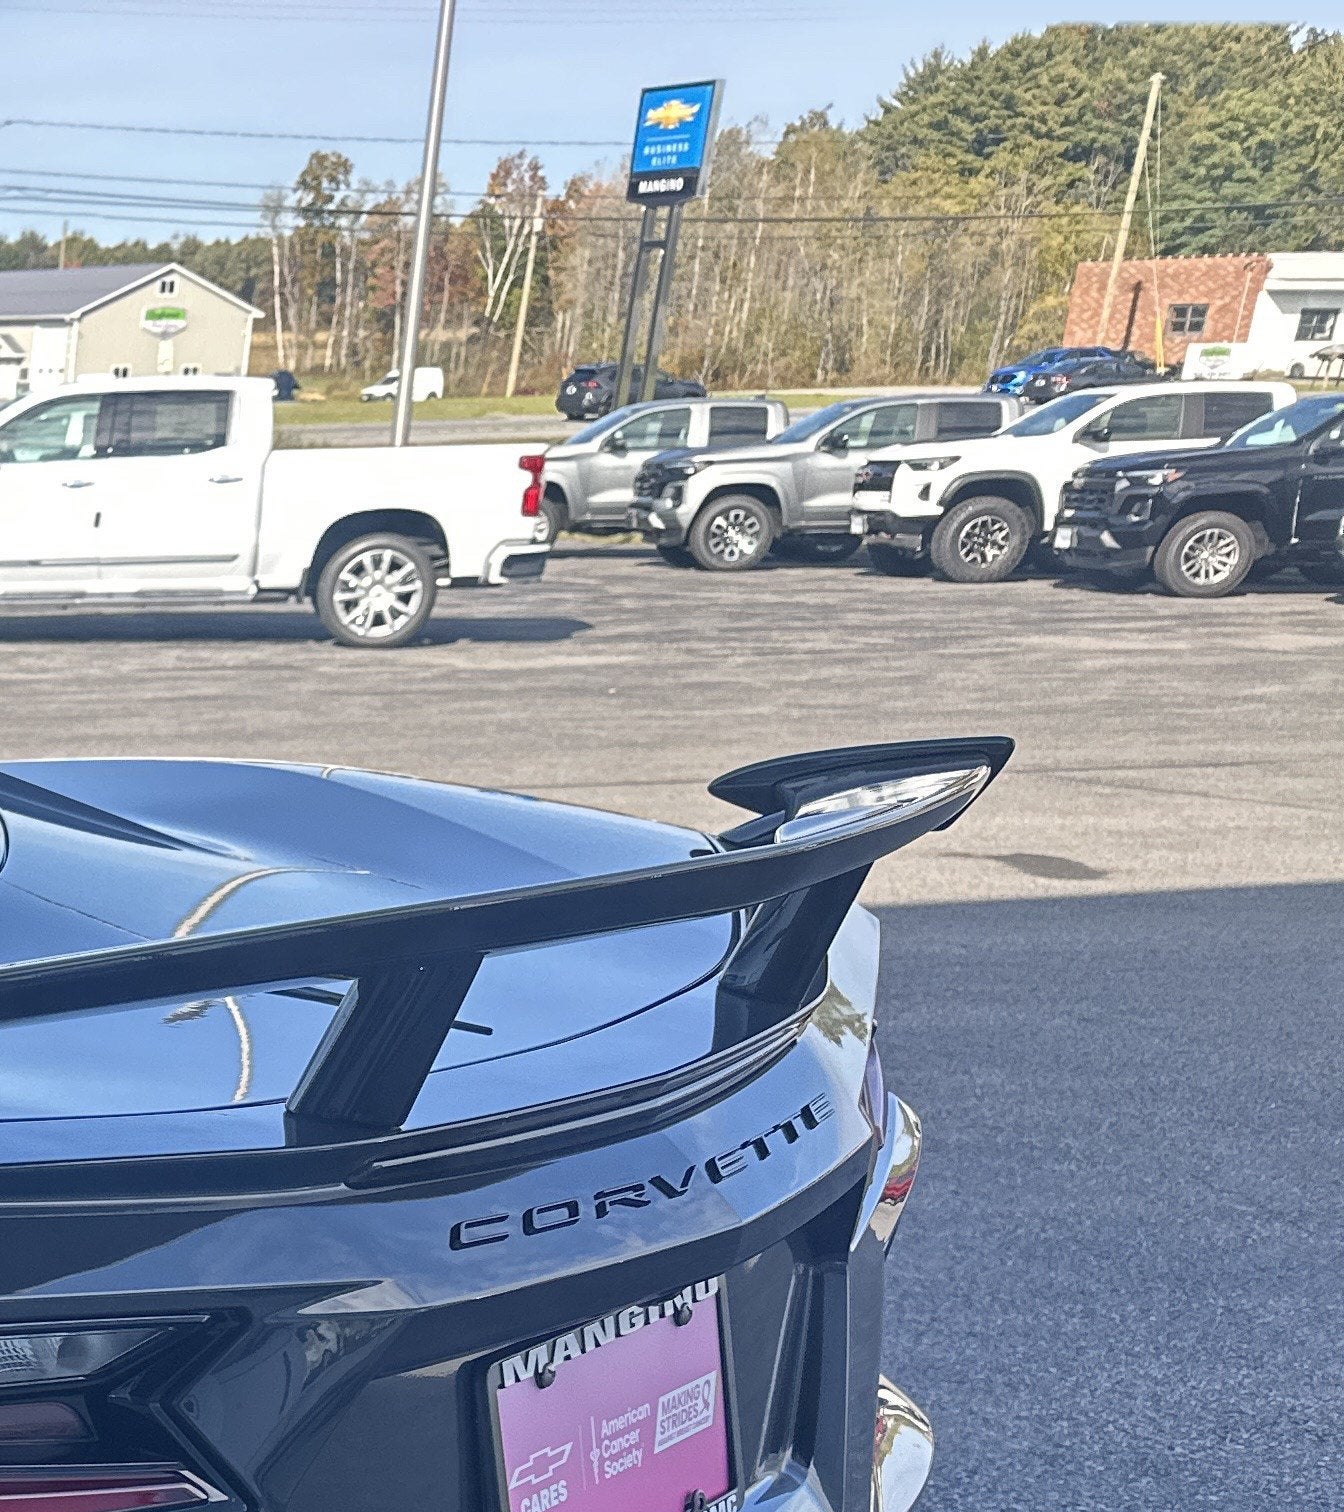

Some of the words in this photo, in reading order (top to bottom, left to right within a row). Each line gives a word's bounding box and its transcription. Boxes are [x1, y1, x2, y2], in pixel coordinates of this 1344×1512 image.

[643, 141, 690, 156] BUSINESS
[638, 177, 684, 194] MANGINO
[448, 1091, 836, 1252] CORVETTE
[661, 1383, 701, 1417] MAKING
[601, 1403, 651, 1439] American
[659, 1402, 699, 1436] STRIDES
[602, 1428, 640, 1458] Cancer
[604, 1447, 643, 1479] Society
